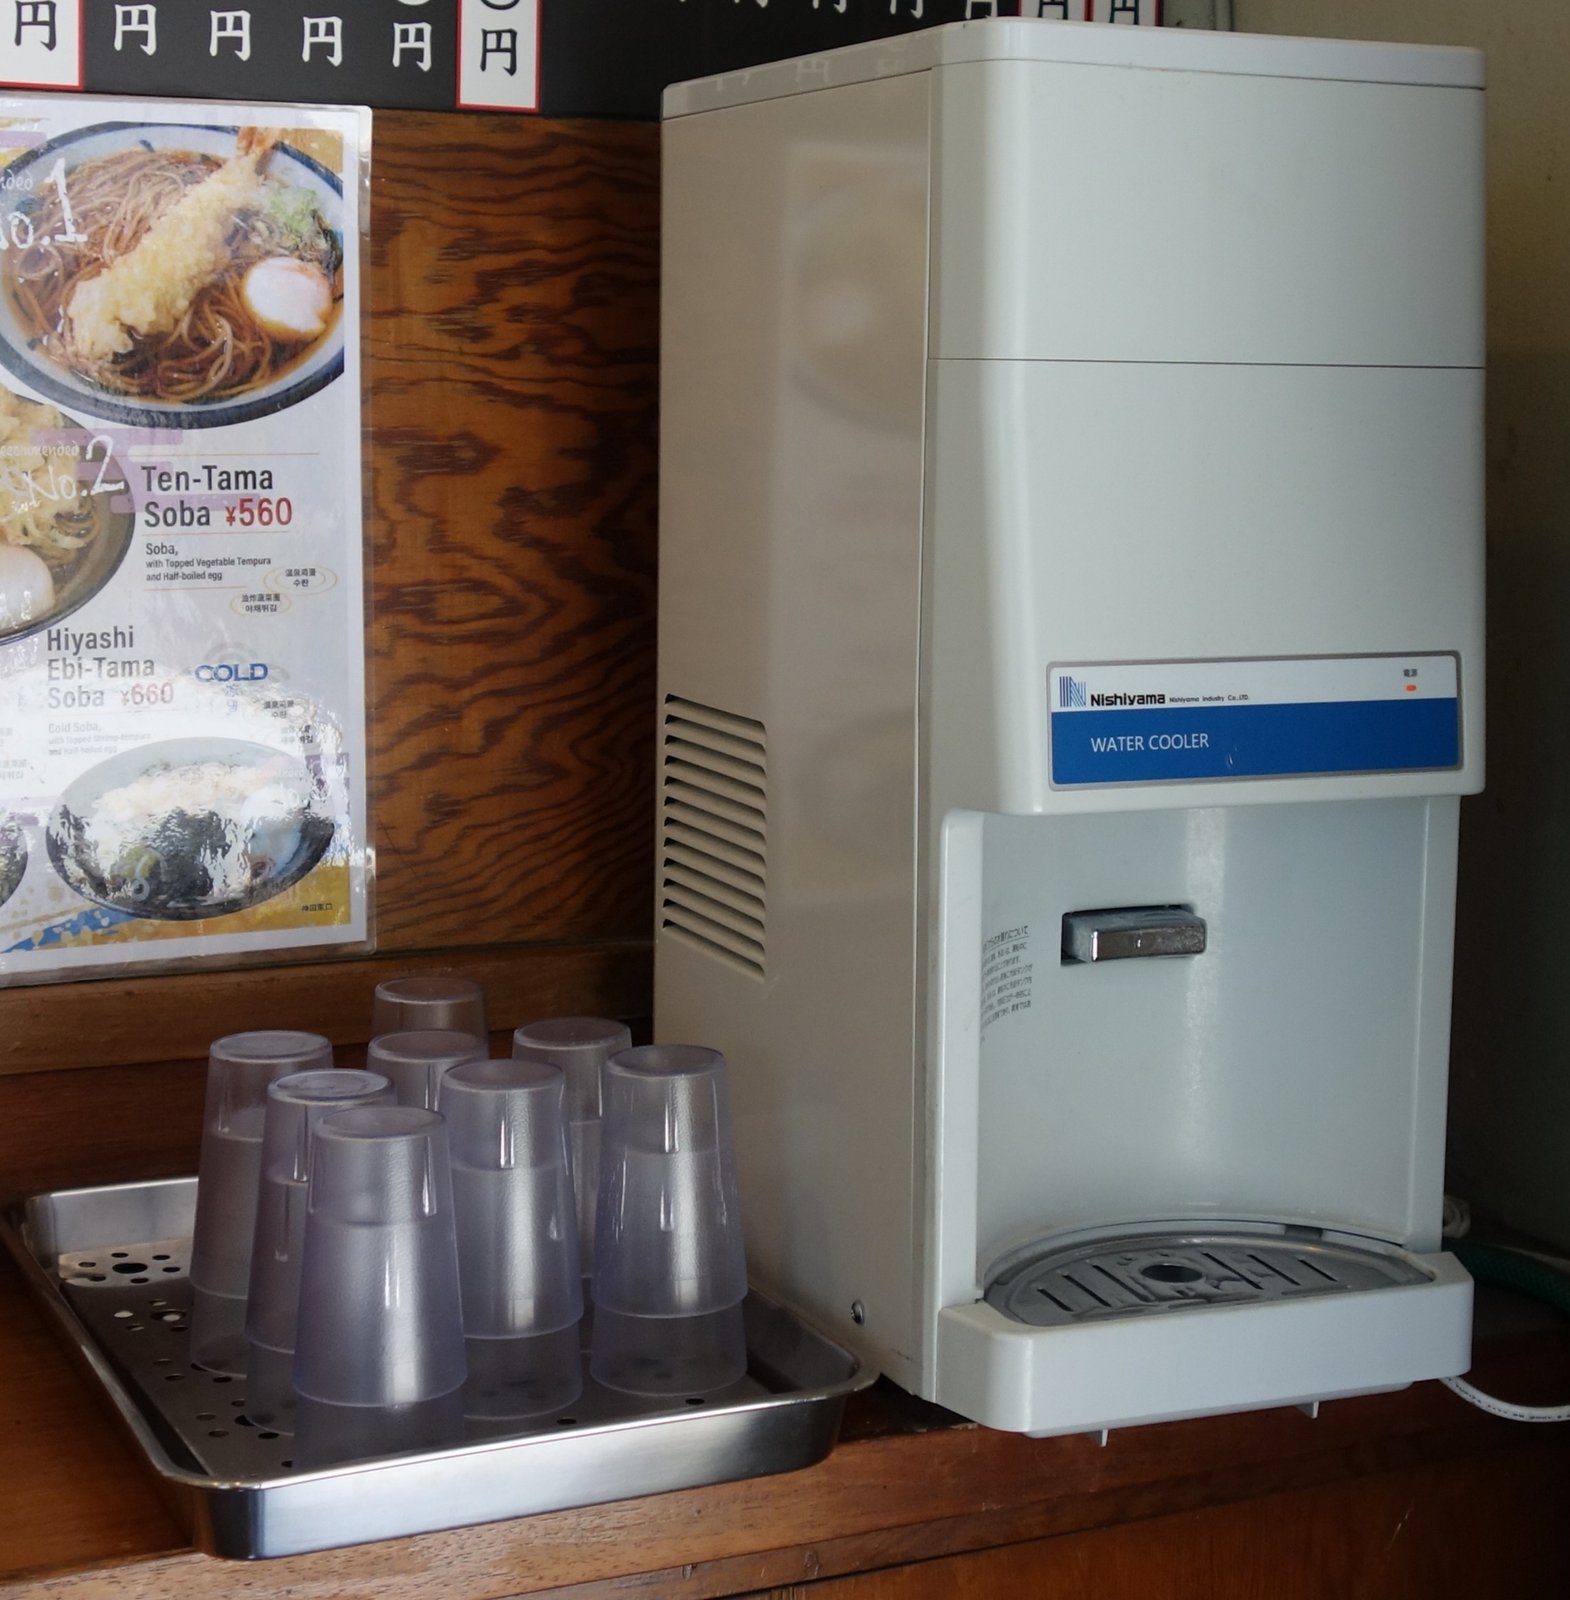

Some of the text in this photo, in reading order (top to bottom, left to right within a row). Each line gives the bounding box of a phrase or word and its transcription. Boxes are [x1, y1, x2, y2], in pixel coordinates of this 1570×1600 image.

[14, 0, 57, 52] 円
[114, 3, 157, 55] 円
[209, 9, 251, 61] 円
[392, 0, 432, 72] 円
[302, 16, 343, 67] 円
[141, 465, 273, 491] Ten-Tama
[144, 497, 293, 527] Soba ¥560
[146, 542, 179, 556] Soba,
[146, 556, 271, 569] with Topped Vegetable Tempura
[146, 573, 161, 581] and
[207, 572, 223, 581] egg
[47, 625, 134, 656] Hiyashi
[47, 656, 155, 681] Ebi-Tama
[195, 663, 268, 682] COLD
[48, 685, 104, 709] Soba
[1090, 692, 1165, 707] Nishiyama
[48, 723, 70, 734] Cold
[1090, 733, 1209, 752] WATER COOLER
